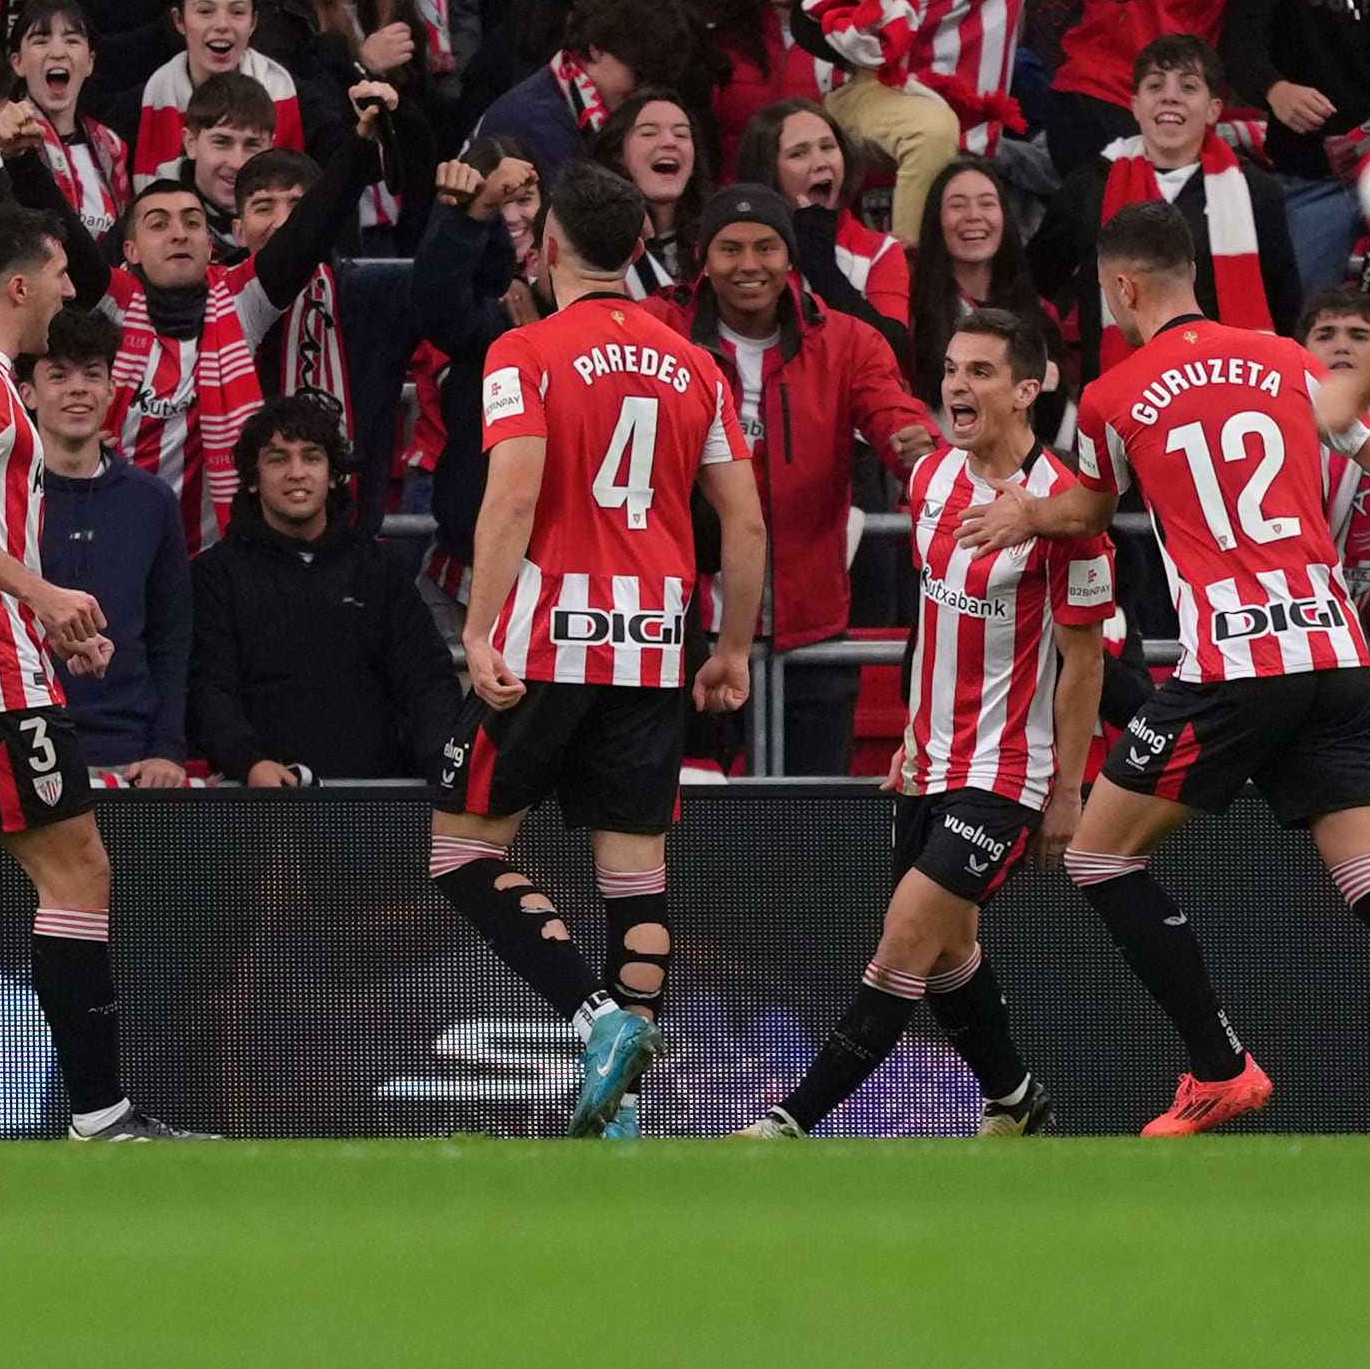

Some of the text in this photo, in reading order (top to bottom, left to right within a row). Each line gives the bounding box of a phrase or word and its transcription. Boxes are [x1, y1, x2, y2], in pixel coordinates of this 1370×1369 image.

[573, 343, 691, 393] PAREDES
[1131, 357, 1283, 426] GURUZETA
[592, 395, 660, 530] 4
[1164, 410, 1302, 551] 12
[552, 609, 683, 645] DIGI
[1214, 598, 1348, 642] DIGI
[19, 716, 58, 773] 3
[943, 812, 1007, 860] vueling
